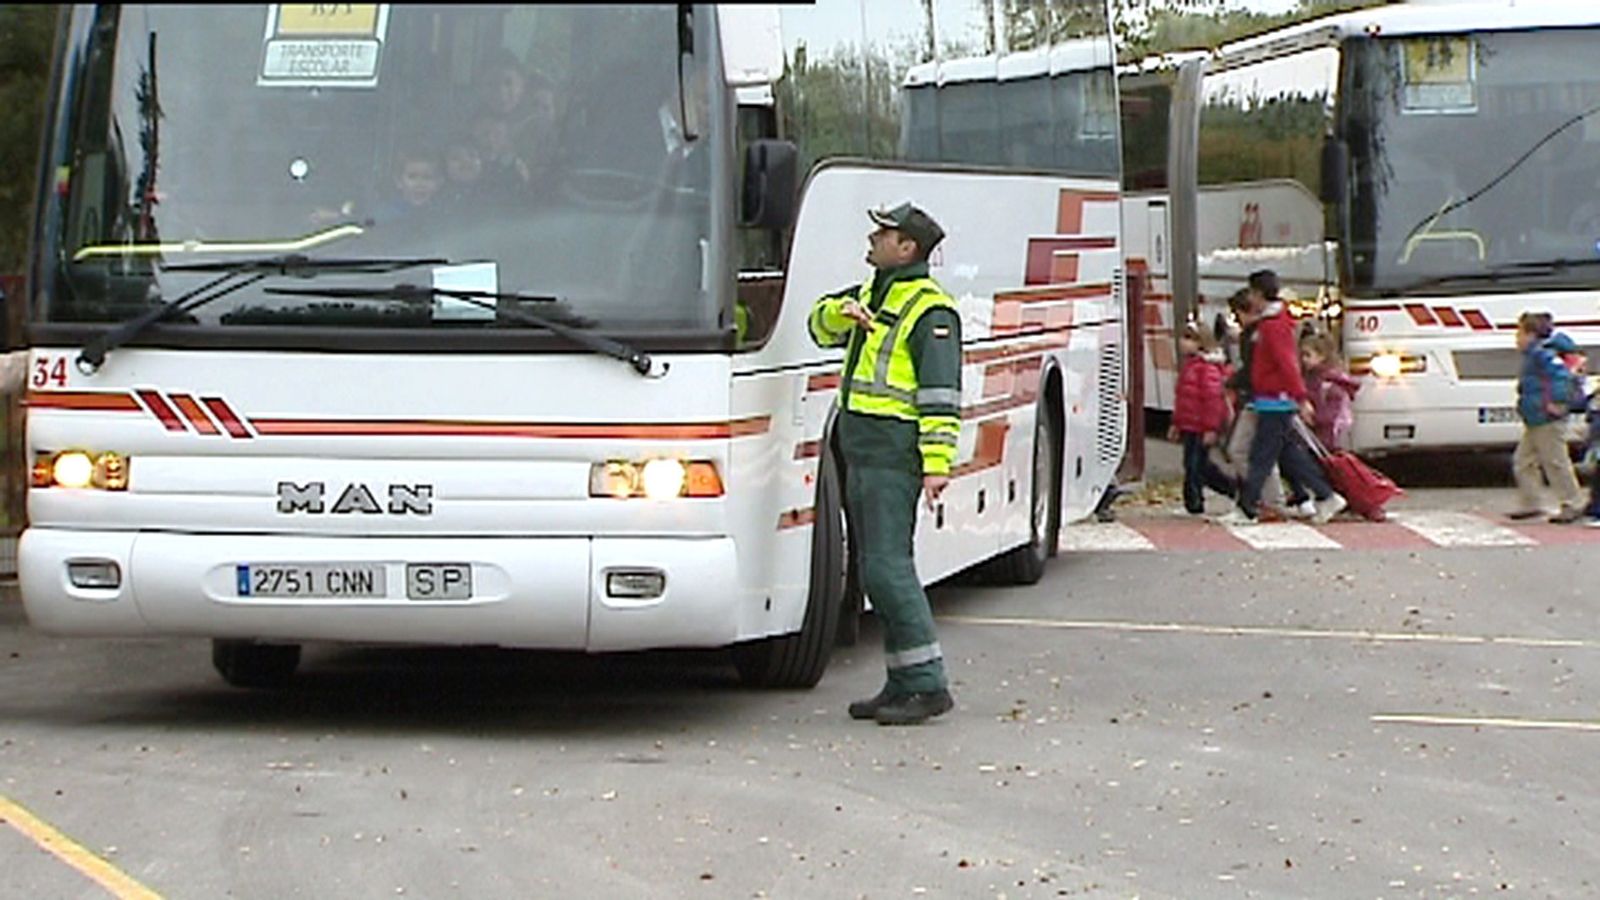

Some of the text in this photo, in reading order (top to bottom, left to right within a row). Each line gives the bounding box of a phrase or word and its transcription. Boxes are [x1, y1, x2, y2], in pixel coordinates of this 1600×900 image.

[281, 44, 363, 58] TRANSPORTE
[289, 59, 350, 73] ESCOLAR
[1355, 315, 1379, 332] 40
[33, 357, 67, 387] 34
[277, 482, 433, 515] MAN
[254, 568, 373, 595] 2751 CNN
